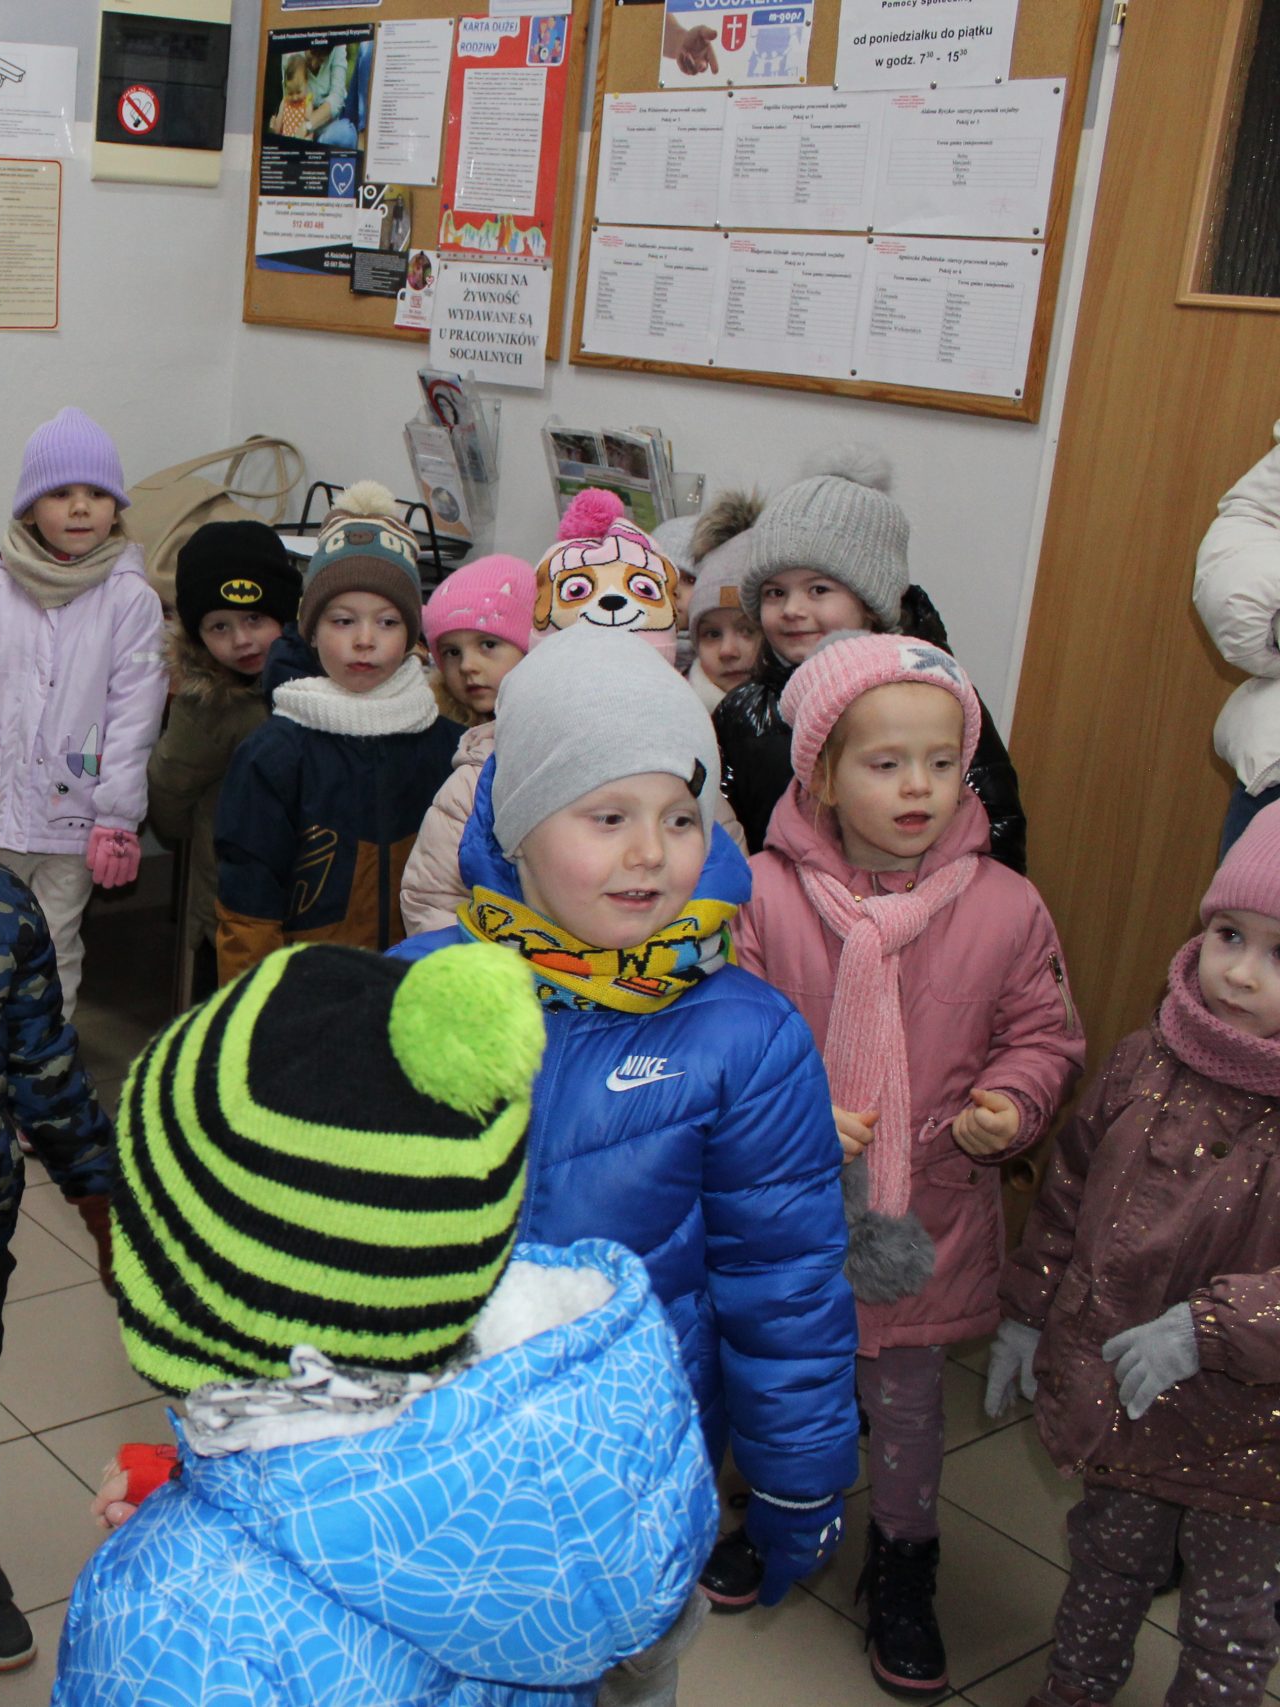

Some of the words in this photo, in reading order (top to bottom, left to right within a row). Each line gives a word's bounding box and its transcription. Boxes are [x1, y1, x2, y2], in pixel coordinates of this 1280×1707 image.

[882, 0, 918, 8] Pomocy
[463, 22, 490, 32] KARTA
[492, 20, 518, 32] DUŻEJ
[853, 34, 867, 46] od
[869, 29, 938, 46] poniedziałku
[940, 27, 955, 39] do
[957, 25, 993, 41] piątku
[460, 42, 498, 53] RODZINY
[874, 58, 883, 67] w
[886, 54, 916, 69] godz.
[460, 271, 508, 285] WNIOSKI
[511, 274, 528, 287] NA
[463, 288, 520, 305] ŻYWNOŚĆ
[448, 308, 517, 325] WYDAWANE
[519, 312, 533, 328] SĄ
[439, 328, 447, 339] U
[449, 328, 540, 347] PRACOWNIKÓW
[449, 347, 523, 365] SOCJALNYCH
[617, 1055, 669, 1078] NIKE
